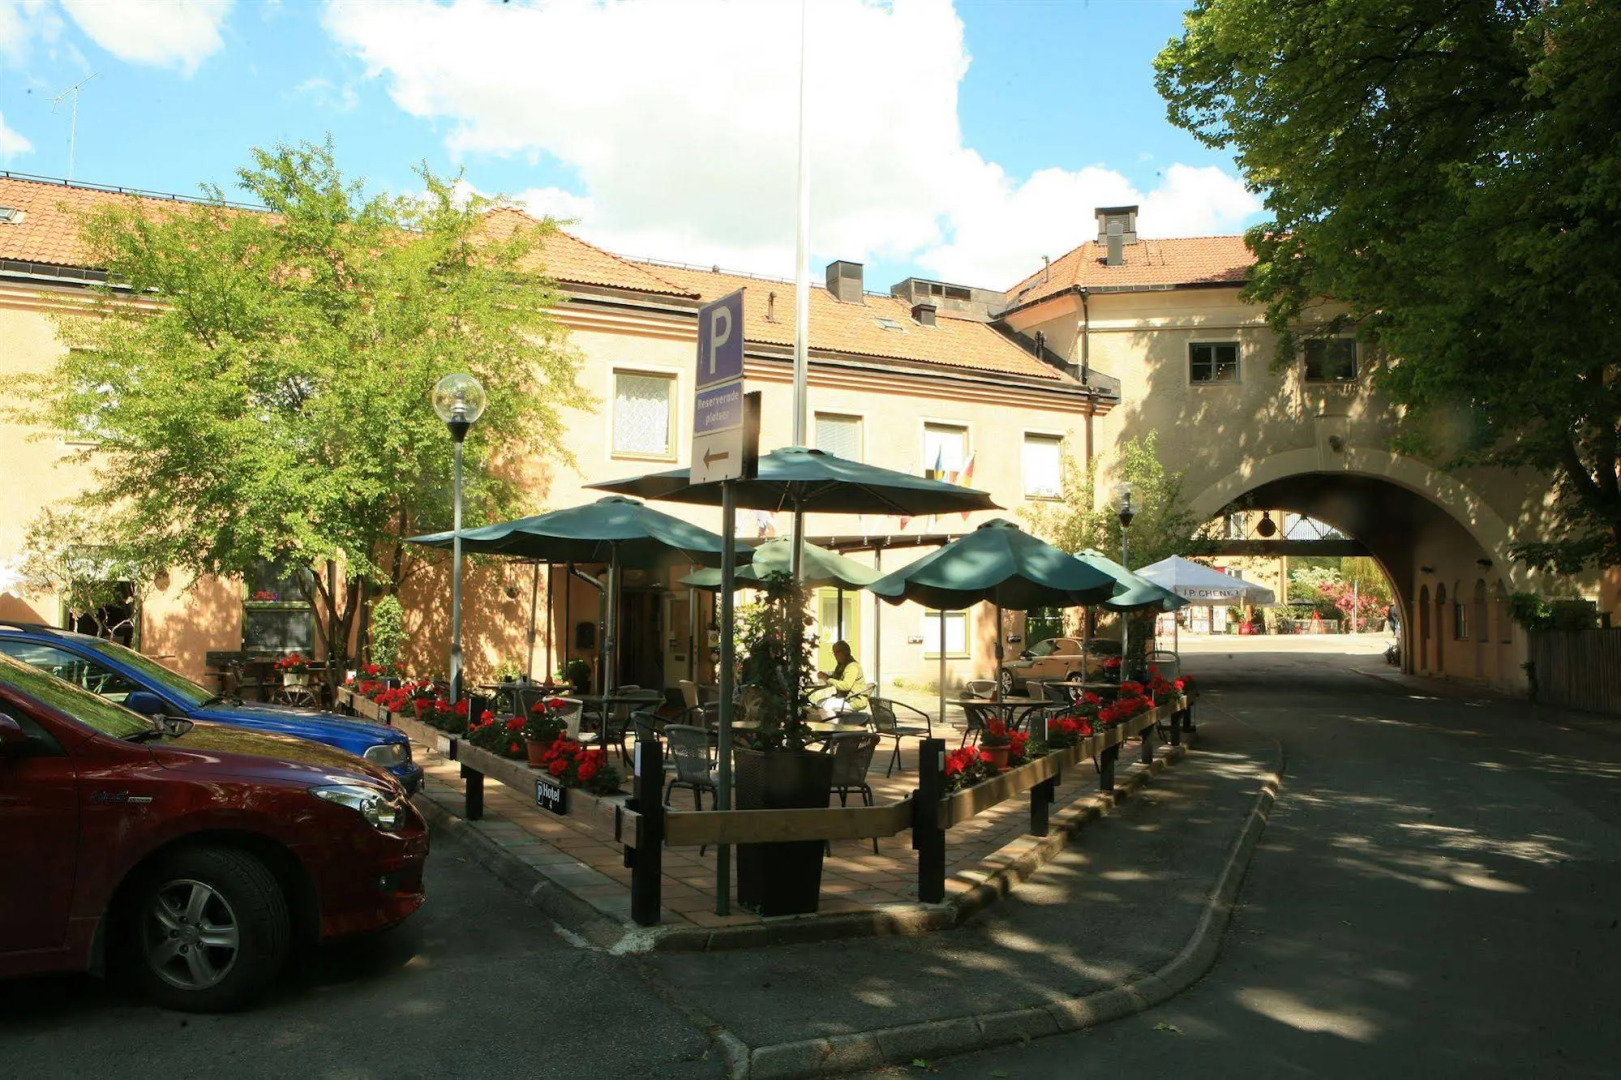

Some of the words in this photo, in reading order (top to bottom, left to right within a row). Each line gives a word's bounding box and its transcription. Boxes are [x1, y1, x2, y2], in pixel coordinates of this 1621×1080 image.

[710, 305, 732, 375] P
[697, 390, 740, 410] Reserverade
[543, 783, 560, 803] Hotel
